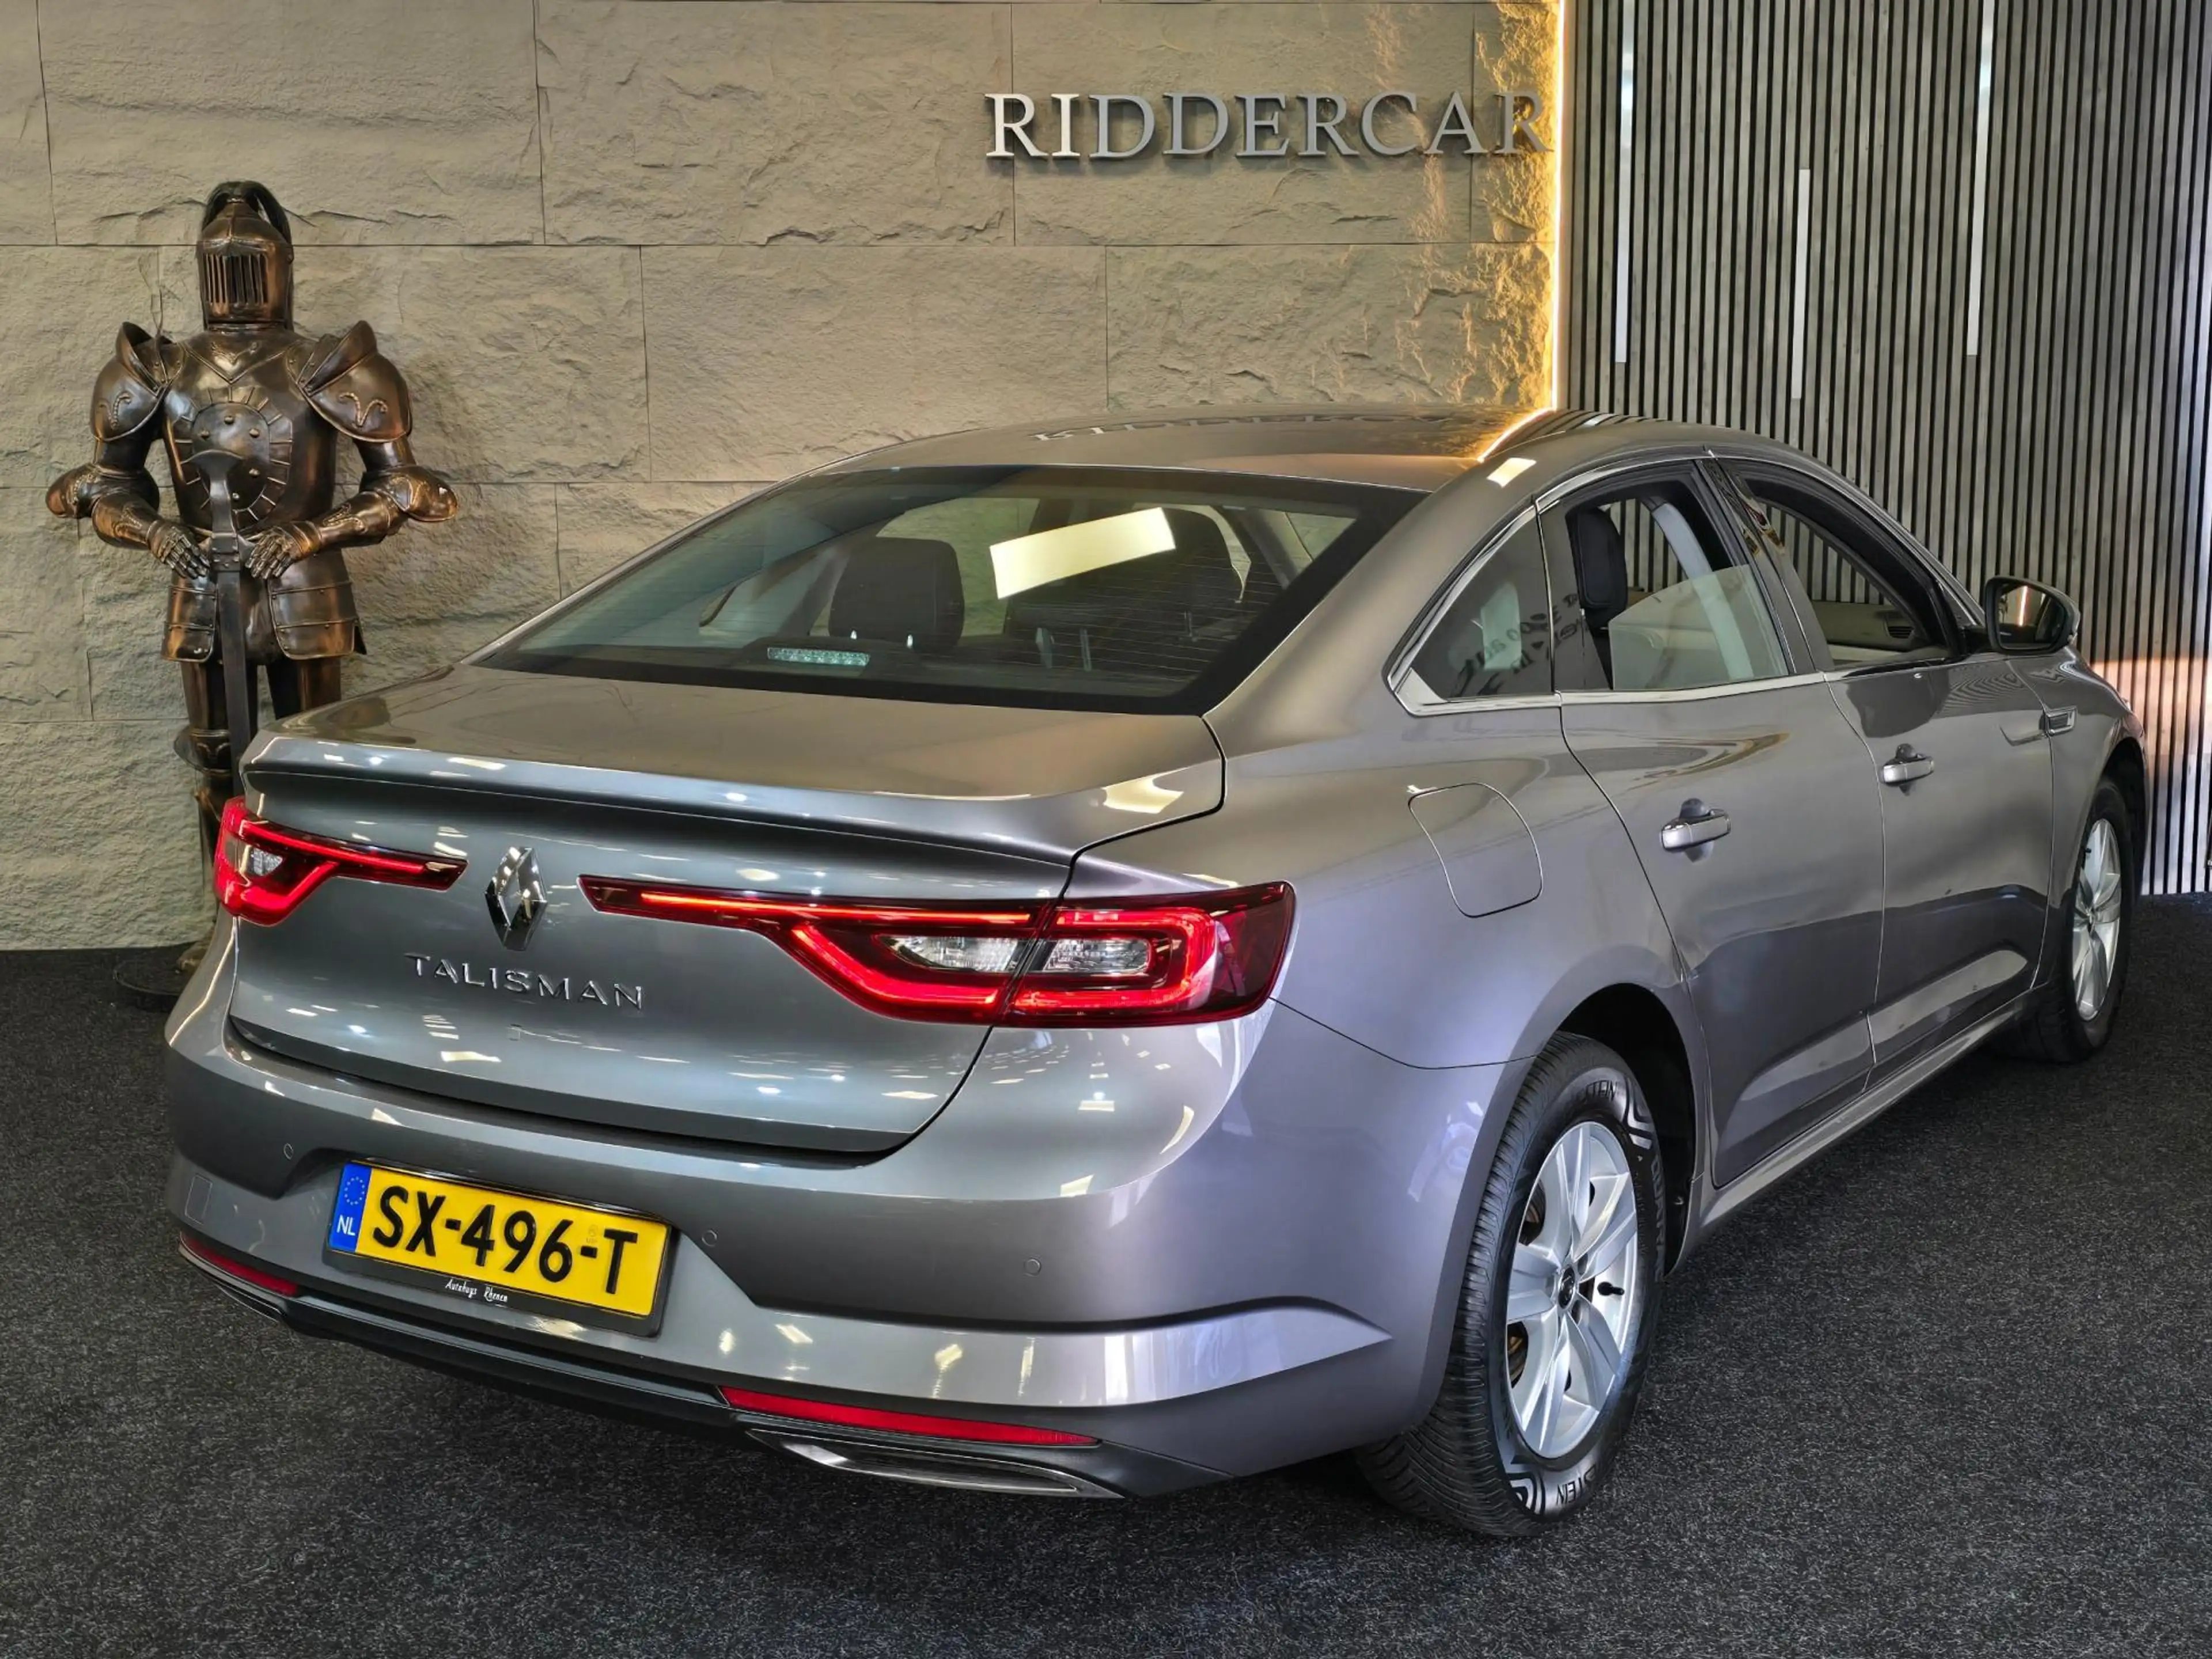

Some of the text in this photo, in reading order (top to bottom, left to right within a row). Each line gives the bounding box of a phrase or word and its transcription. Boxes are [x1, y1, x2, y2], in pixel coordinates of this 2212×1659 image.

[984, 90, 1554, 158] RIDDERCAR
[403, 952, 643, 1010] TALISMAN
[336, 1214, 356, 1236] NL
[372, 1185, 639, 1294] SX-496-T
